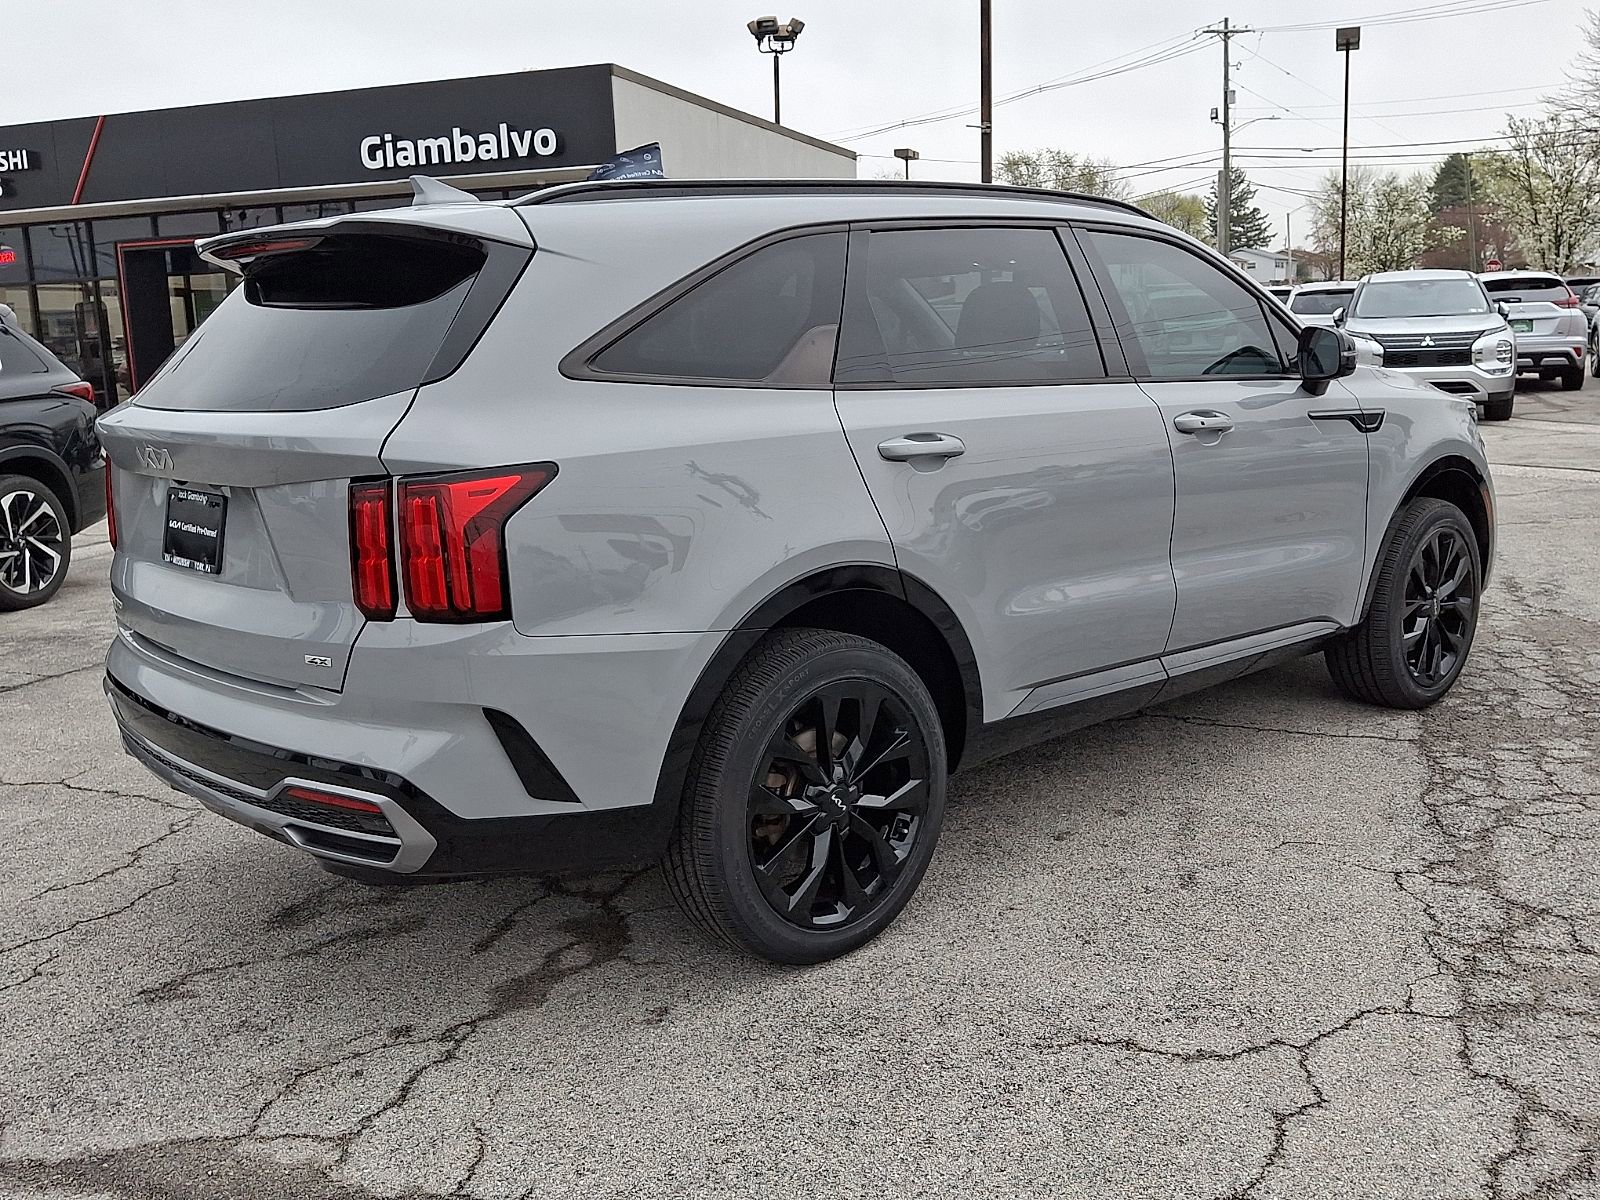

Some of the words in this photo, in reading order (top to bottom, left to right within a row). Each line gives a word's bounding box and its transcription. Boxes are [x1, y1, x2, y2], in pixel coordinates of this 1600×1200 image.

[360, 122, 557, 170] Giambalvo
[178, 489, 187, 499] Jack
[169, 520, 181, 529] KIA
[181, 522, 197, 533] Certified
